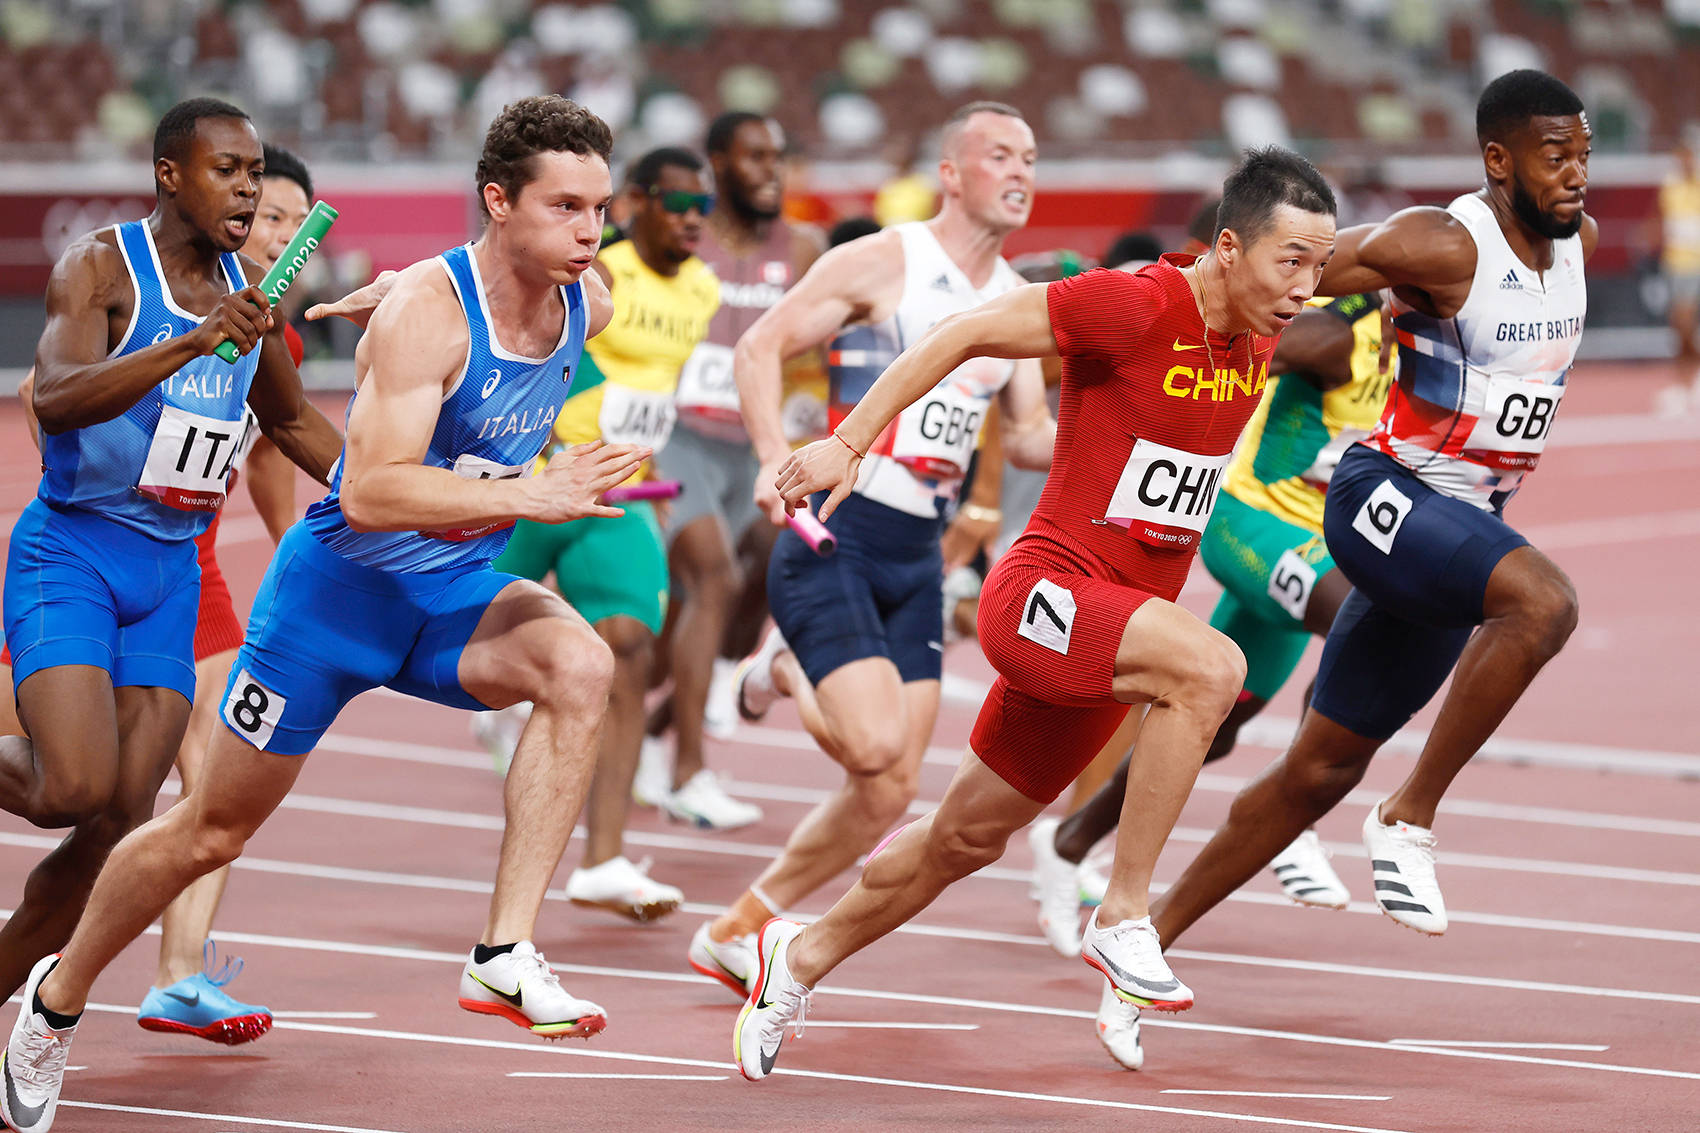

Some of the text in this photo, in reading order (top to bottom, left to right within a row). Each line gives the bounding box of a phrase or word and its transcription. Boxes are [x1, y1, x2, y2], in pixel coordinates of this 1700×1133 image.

[268, 236, 319, 307] YO 2020
[1496, 323, 1543, 341] GREAT
[161, 372, 233, 399] ITALIA
[1162, 360, 1267, 402] CHINA
[477, 405, 555, 439] ITALIA
[1496, 393, 1562, 440] GB
[1137, 459, 1223, 516] CHN
[1144, 528, 1164, 540] TOKYO
[1367, 501, 1399, 535] 6
[1275, 567, 1303, 603] 5
[1026, 590, 1067, 635] 7
[232, 683, 269, 733] 8
